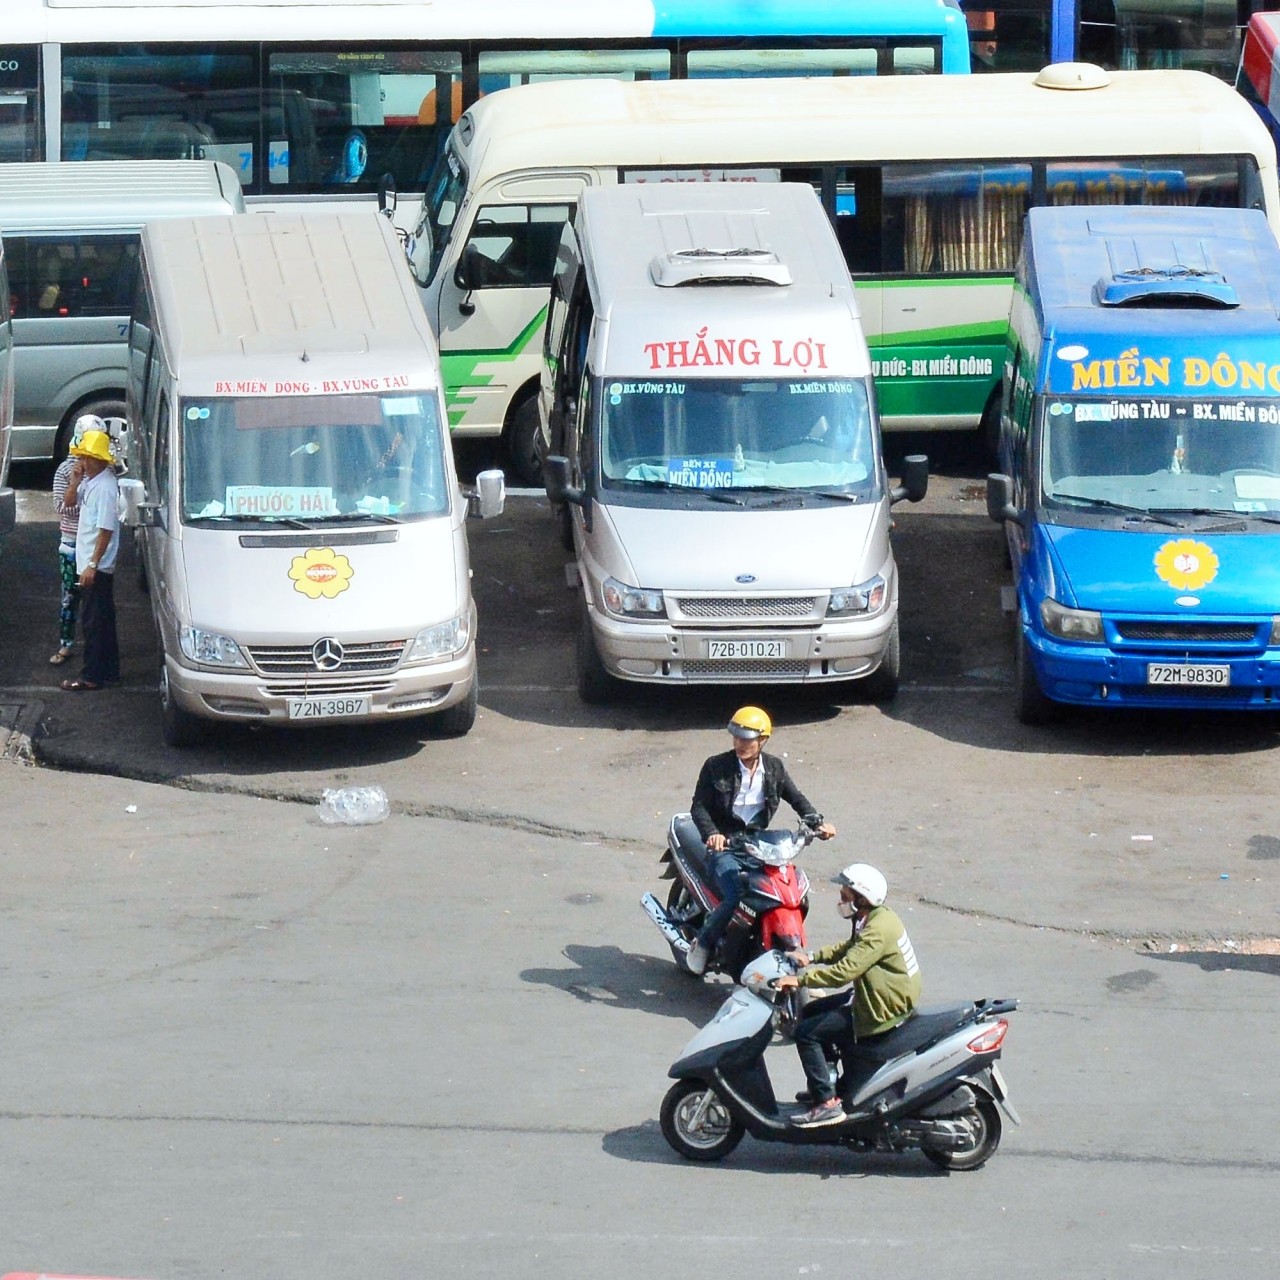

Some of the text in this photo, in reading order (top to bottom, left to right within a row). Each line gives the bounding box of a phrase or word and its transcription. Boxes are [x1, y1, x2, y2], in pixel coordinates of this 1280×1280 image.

[644, 325, 829, 374] THẮNG LỢI
[929, 353, 993, 377] MIỀN ĐÔNG
[1072, 346, 1171, 391] MIỀN
[382, 374, 410, 389] TÀU
[665, 382, 686, 395] TÀU
[1140, 399, 1170, 420] TÀU
[1219, 400, 1257, 423] MIỀN
[702, 461, 717, 469] XE
[669, 468, 733, 488] MIỀN ĐÔNG
[711, 642, 782, 658] 72B-010.21
[1153, 667, 1224, 683] 72M-9830
[293, 699, 364, 718] 72N-3967
